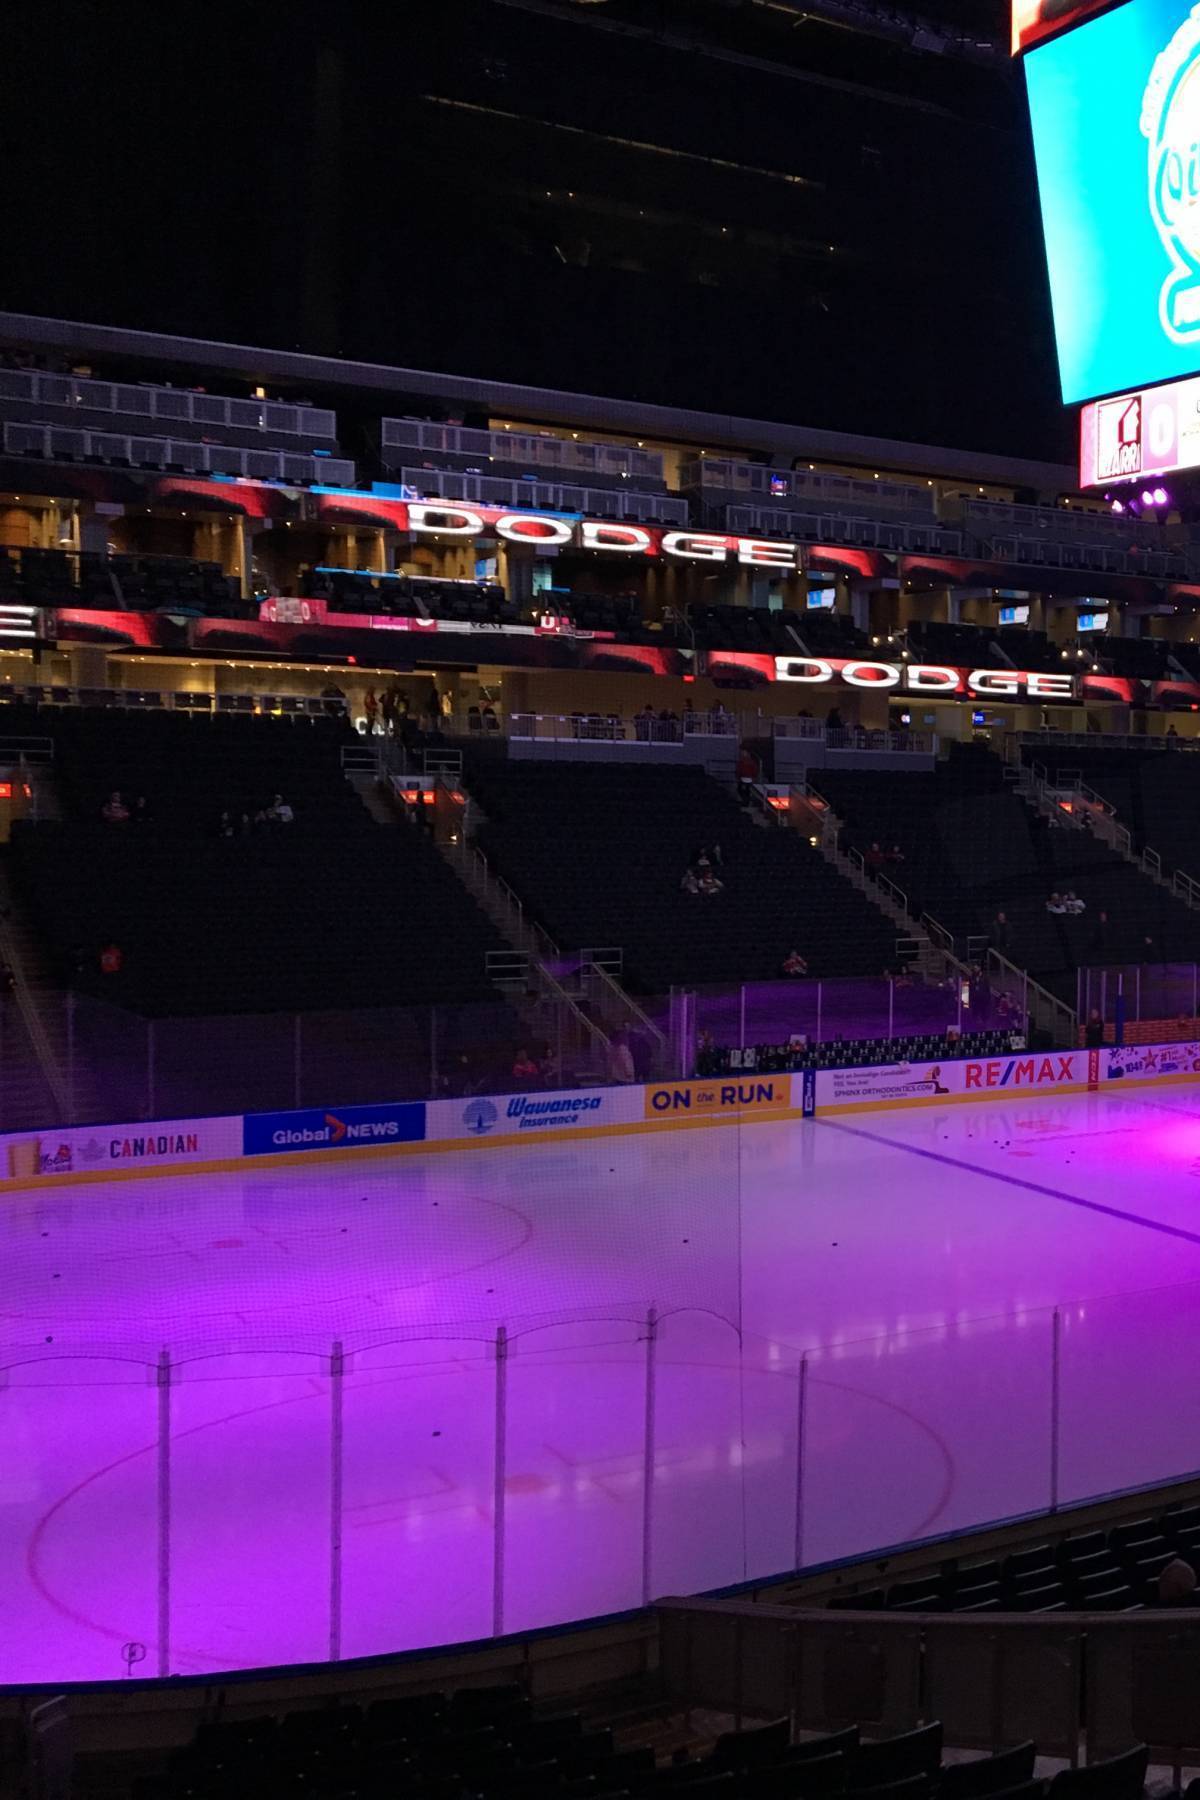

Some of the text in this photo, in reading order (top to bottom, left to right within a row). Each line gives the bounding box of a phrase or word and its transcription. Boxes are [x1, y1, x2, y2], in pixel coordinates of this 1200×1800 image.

[407, 503, 797, 568] DODGE
[775, 656, 1072, 697] DODGE
[965, 1057, 1074, 1088] RE/MAX
[506, 1095, 602, 1118] Wawanesa
[652, 1089, 691, 1111] ON
[721, 1083, 773, 1105] RUN
[110, 1134, 198, 1159] CANADIAN
[273, 1121, 399, 1145] Global NEWS
